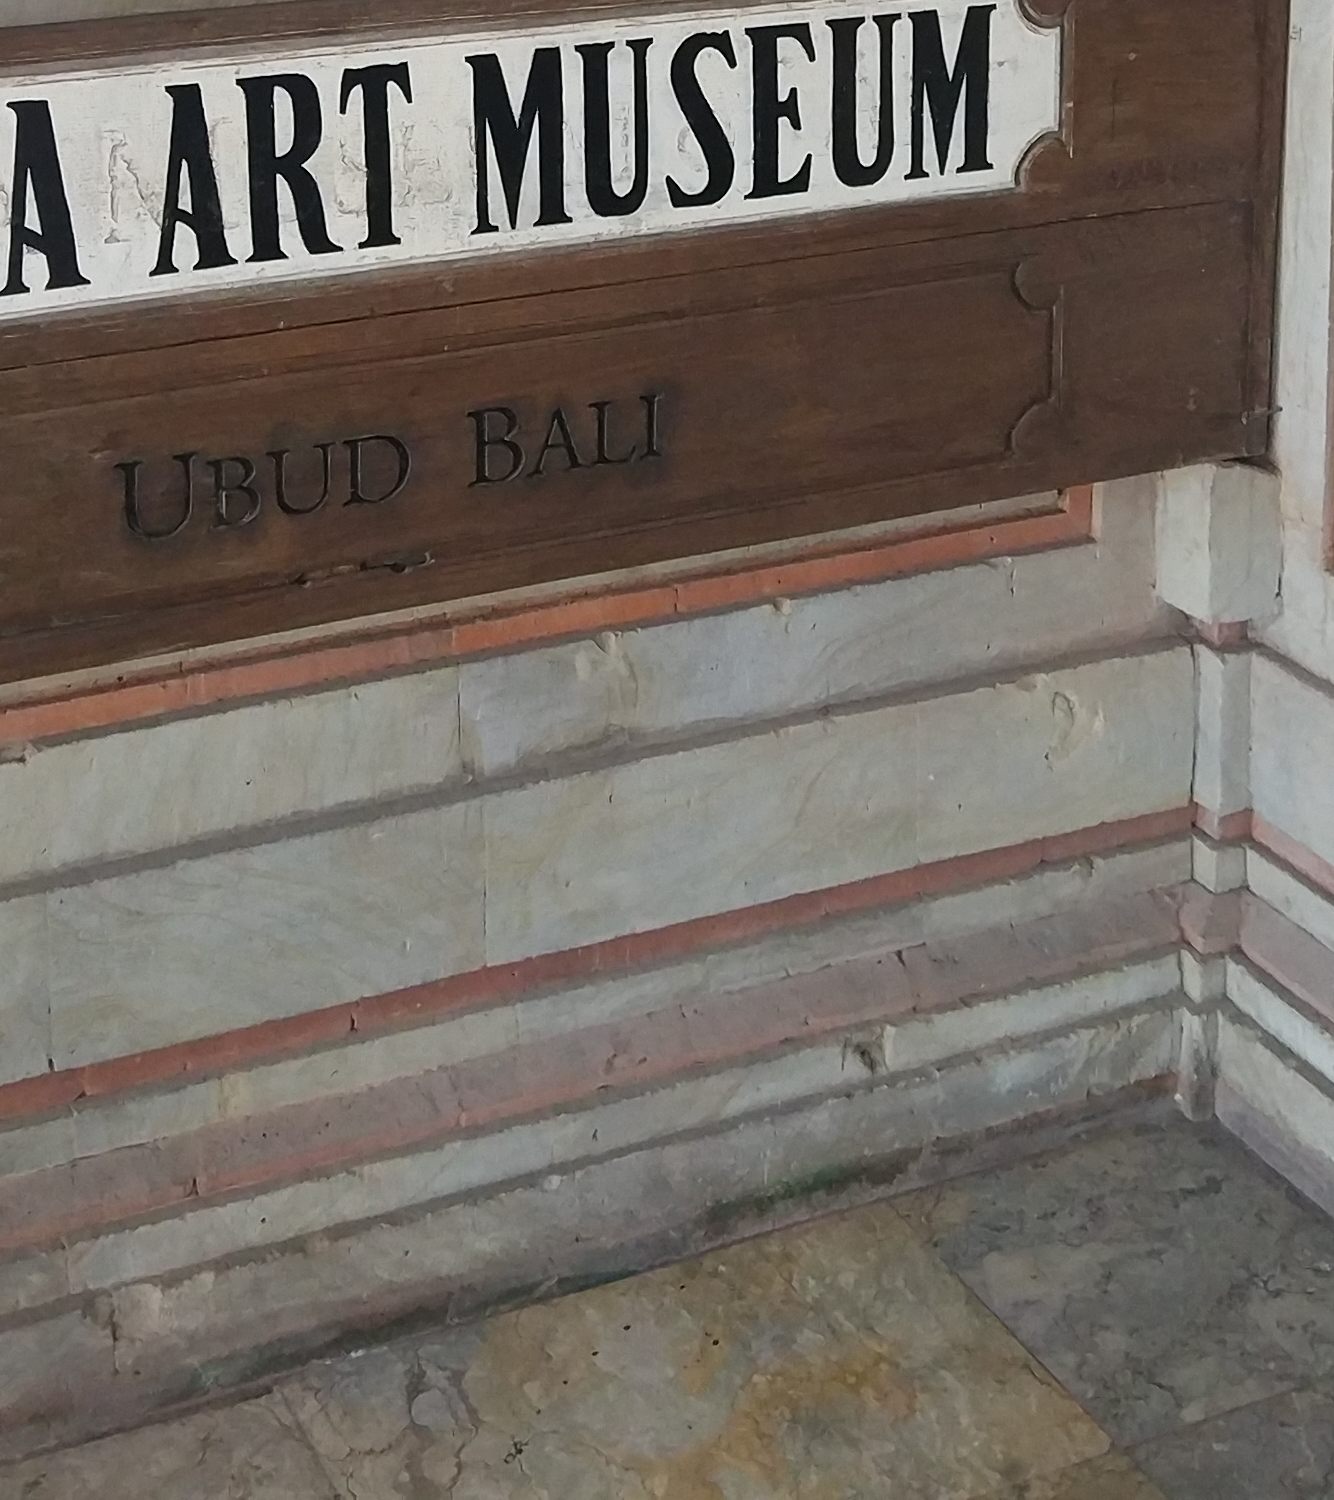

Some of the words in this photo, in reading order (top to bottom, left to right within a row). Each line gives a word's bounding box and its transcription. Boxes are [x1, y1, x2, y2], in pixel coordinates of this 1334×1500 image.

[148, 61, 413, 277] ART
[464, 3, 998, 236] MUSEUM
[113, 433, 413, 541] UBUD
[467, 393, 665, 489] BALI
